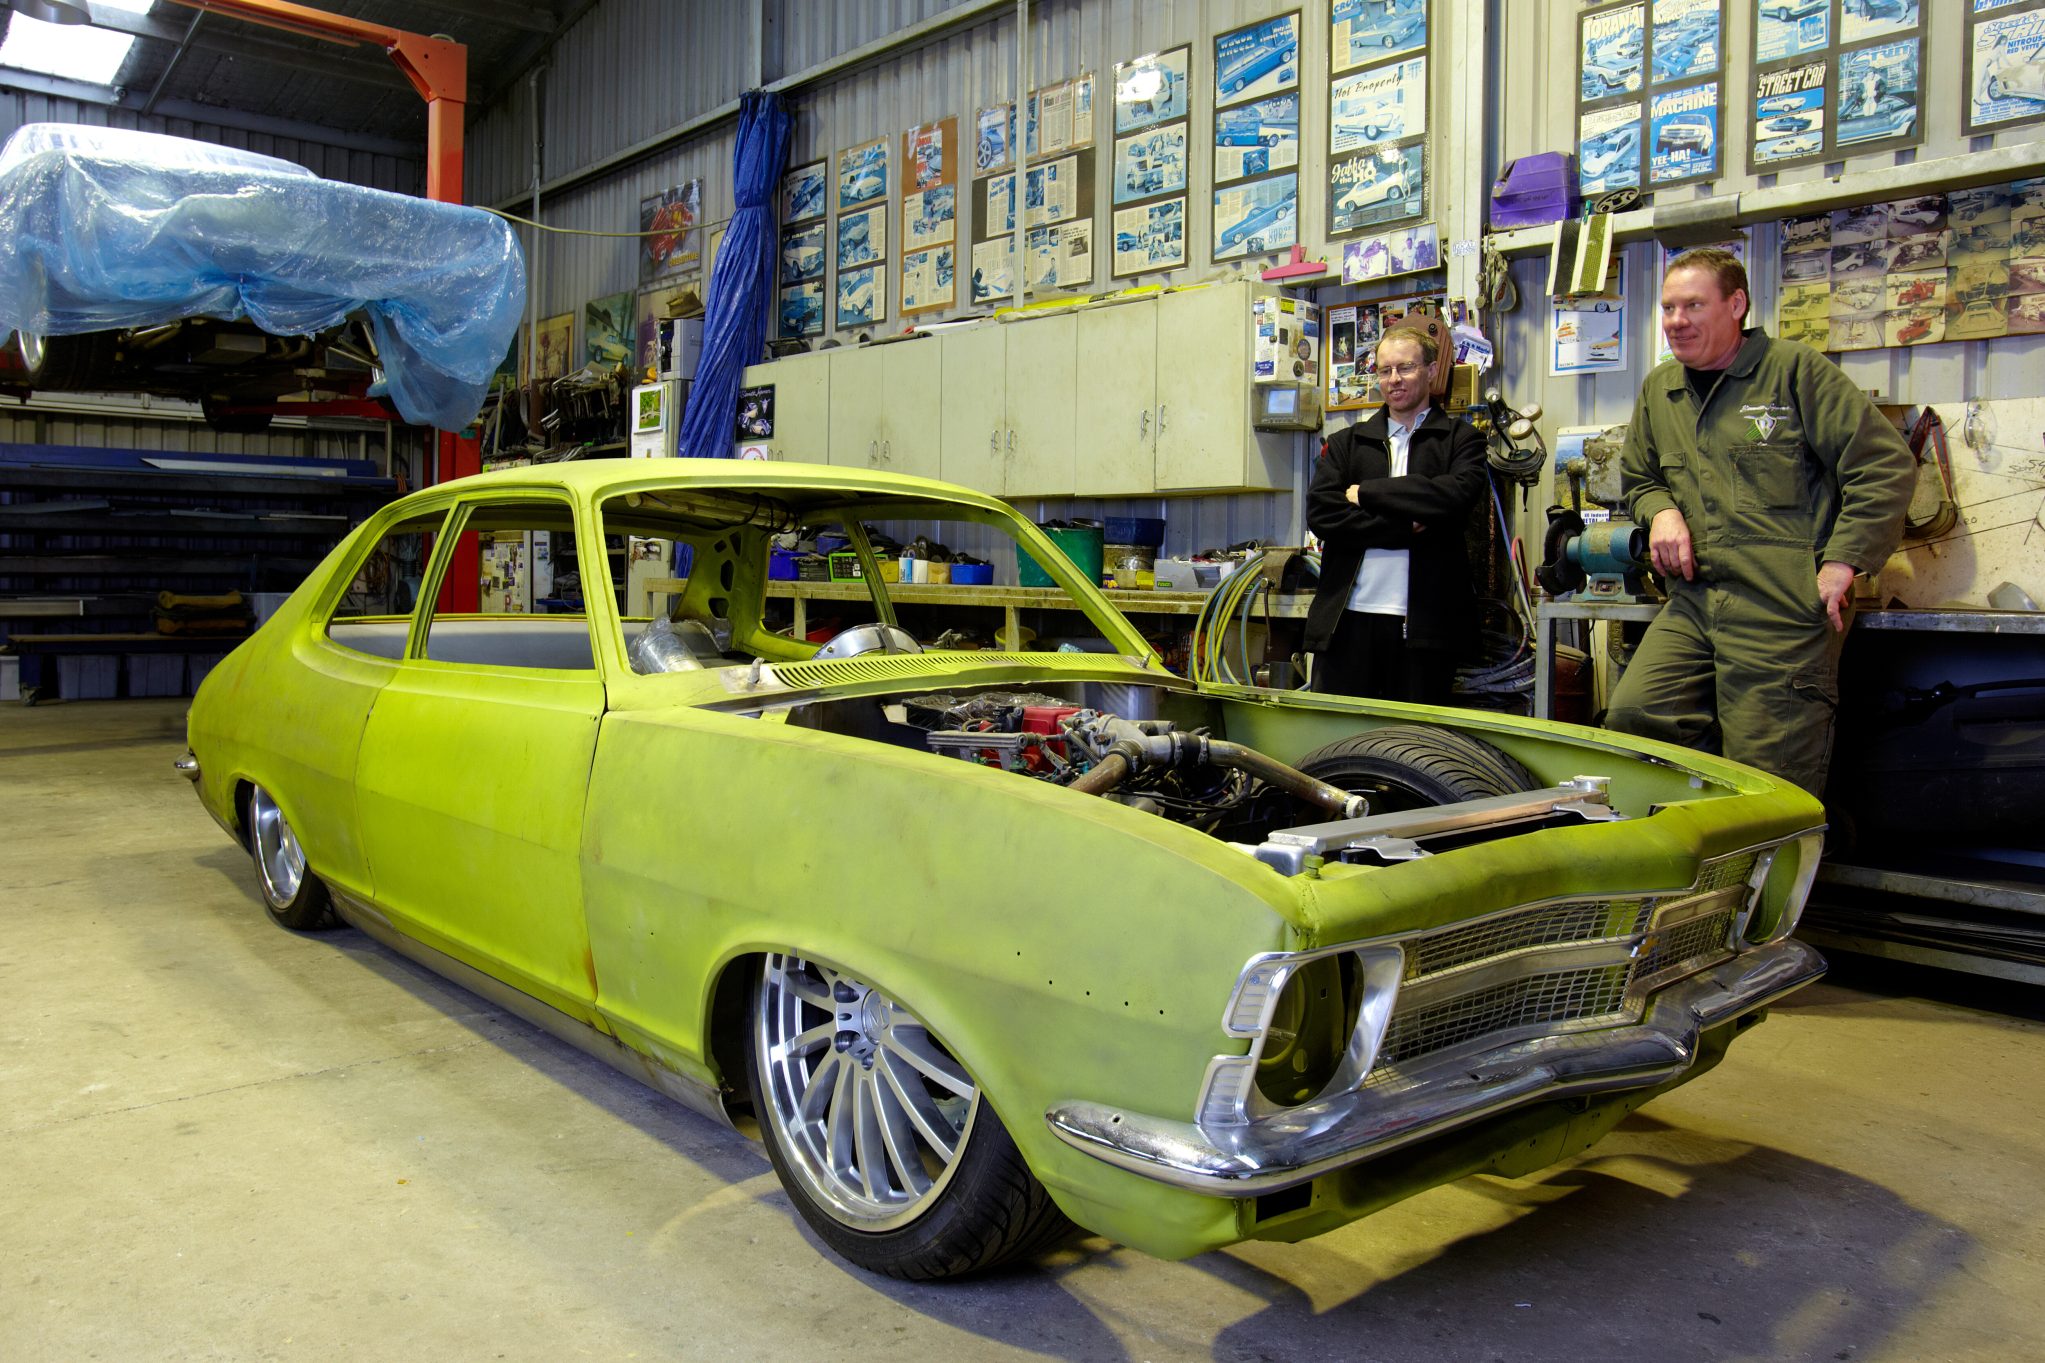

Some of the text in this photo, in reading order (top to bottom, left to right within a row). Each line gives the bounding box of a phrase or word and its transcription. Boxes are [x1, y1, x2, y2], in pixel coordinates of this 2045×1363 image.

[1582, 6, 1641, 40] TORANA
[1976, 19, 2045, 48] STRI
[2022, 43, 2040, 51] VETTE
[1334, 73, 1402, 99] Hot Property
[1757, 70, 1805, 98] STREET
[1802, 65, 1827, 89] CAR
[1651, 89, 1717, 119] MACHINE
[1652, 148, 1691, 166] YEE-HA!
